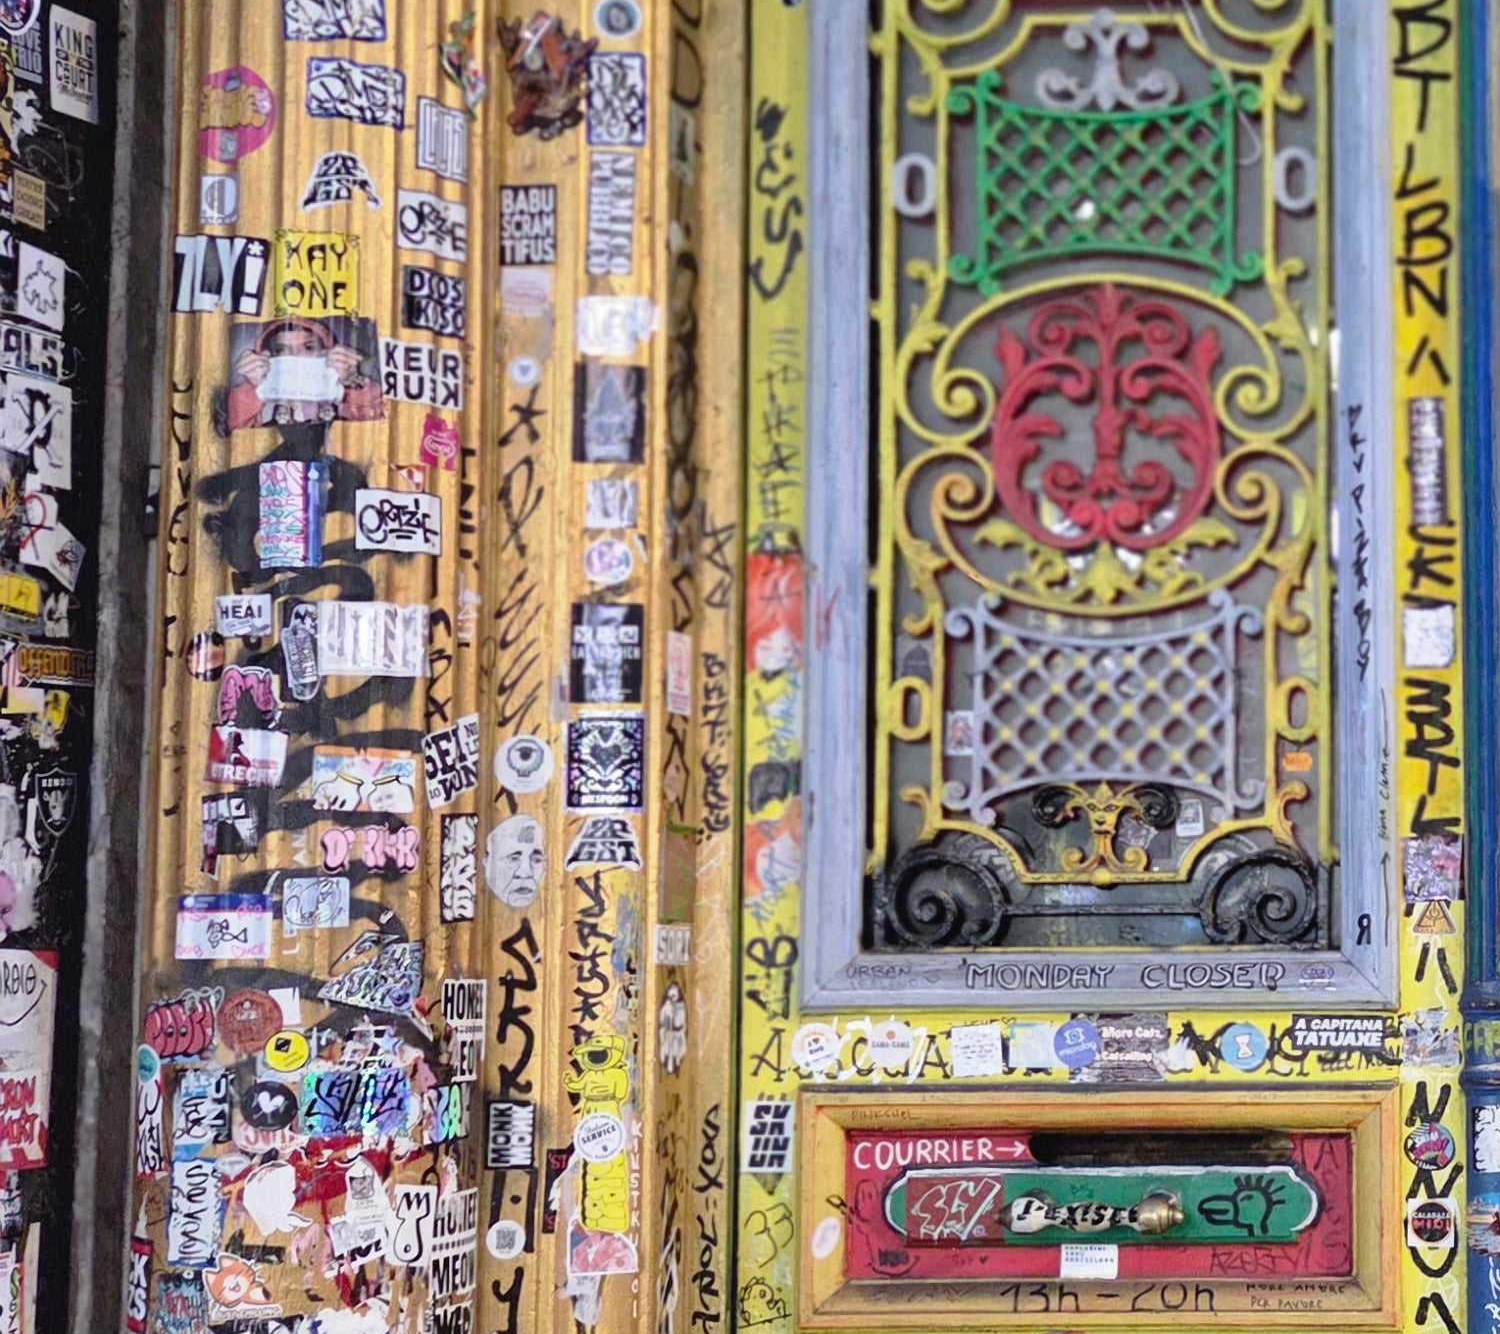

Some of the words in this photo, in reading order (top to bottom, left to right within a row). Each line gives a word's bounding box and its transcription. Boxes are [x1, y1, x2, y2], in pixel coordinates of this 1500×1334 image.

[55, 21, 93, 60] KING
[503, 188, 555, 214] BABU
[502, 214, 555, 239] SCRAM
[285, 237, 348, 279] KAY
[503, 239, 555, 264] TIFUS
[283, 279, 346, 309] ONE
[964, 960, 1113, 990] MONDAY
[1309, 1019, 1383, 1032] CAPITANA
[491, 1105, 511, 1165] MONK
[512, 1105, 533, 1165] MONK
[582, 1125, 617, 1145] SERVICE
[853, 1138, 992, 1169] COURRIER
[1000, 1283, 1080, 1313] 13h
[1131, 1282, 1215, 1313] 20h
